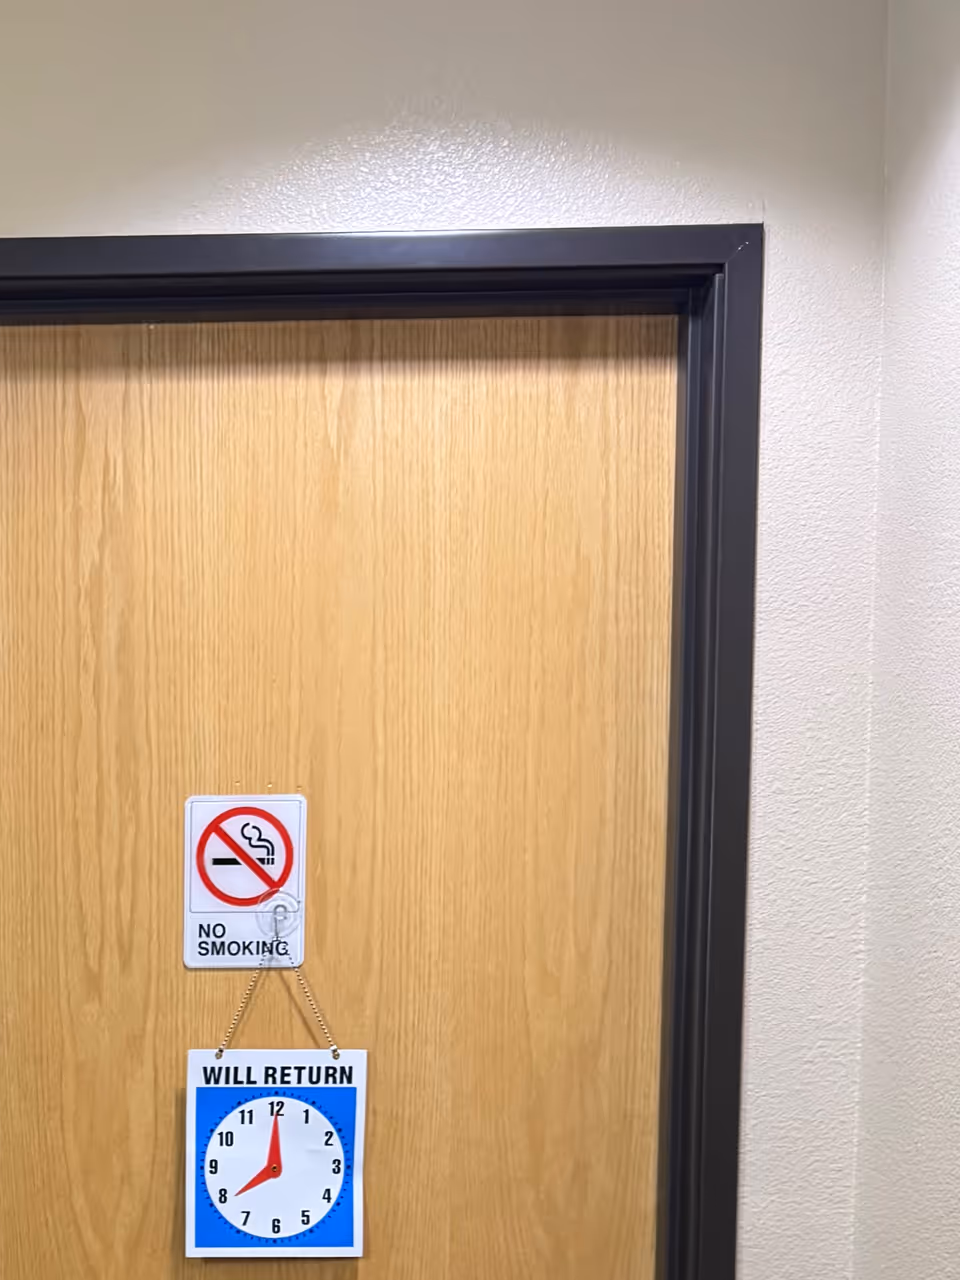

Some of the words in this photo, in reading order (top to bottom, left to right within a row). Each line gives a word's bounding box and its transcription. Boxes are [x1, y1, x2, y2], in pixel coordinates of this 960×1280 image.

[197, 923, 227, 939] NO
[197, 940, 290, 957] SMOKING
[202, 1066, 257, 1085] WILL
[263, 1066, 353, 1085] RETURN
[238, 1109, 254, 1125] 11
[268, 1101, 285, 1117] 12
[302, 1109, 310, 1124] 1
[217, 1131, 234, 1147] 10
[324, 1131, 334, 1146] 2
[208, 1159, 218, 1175] 9
[332, 1158, 341, 1174] 3
[218, 1188, 228, 1204] 8
[322, 1188, 332, 1203] 4
[241, 1211, 251, 1226] 7
[301, 1210, 310, 1225] 5
[272, 1218, 281, 1234] 6
